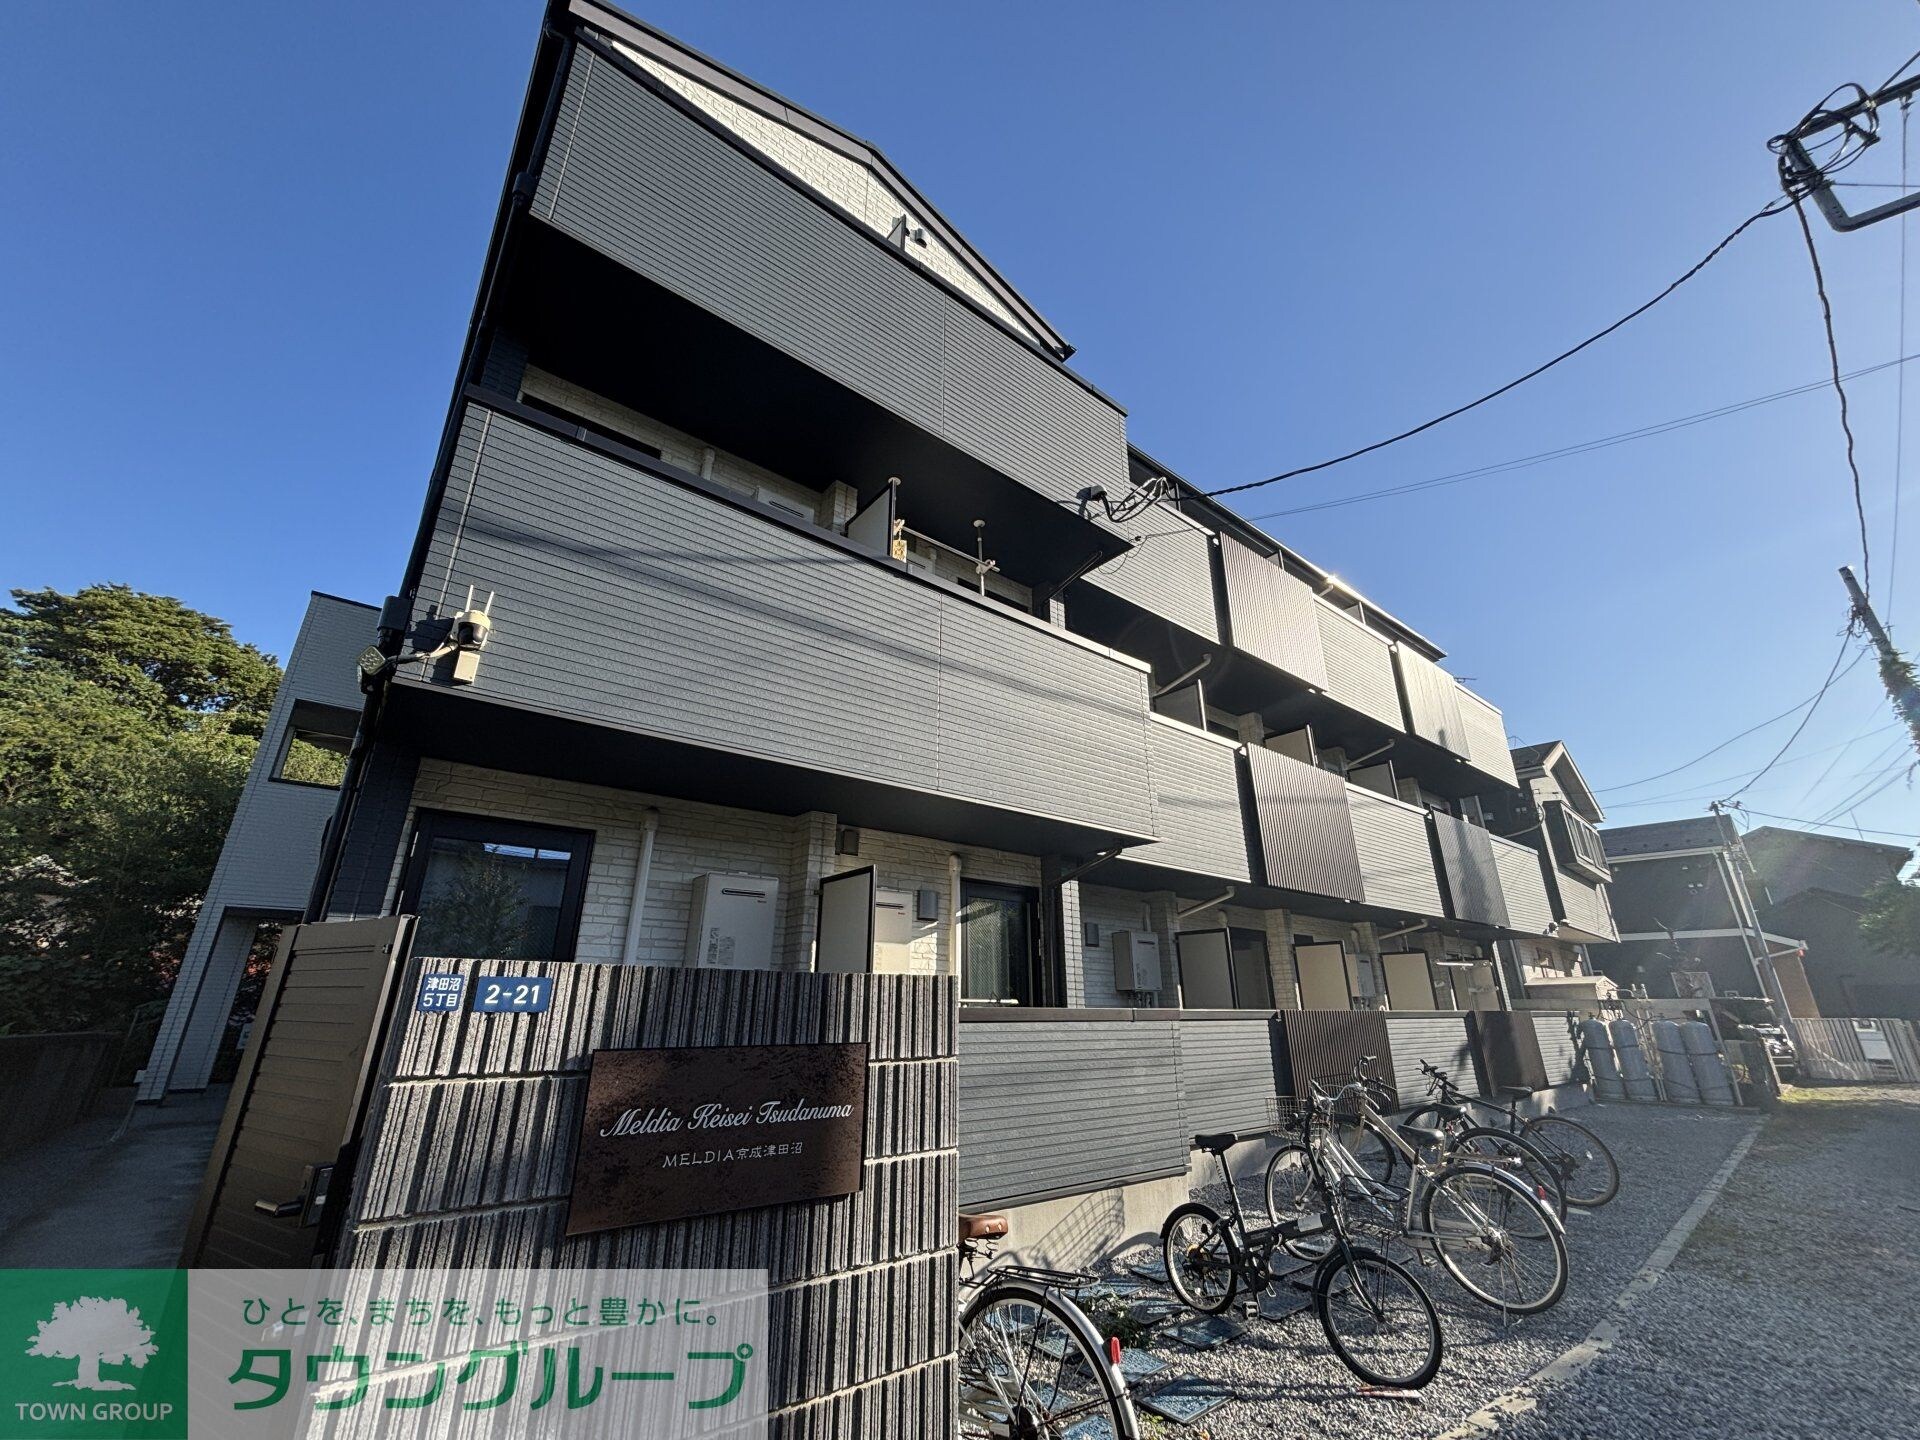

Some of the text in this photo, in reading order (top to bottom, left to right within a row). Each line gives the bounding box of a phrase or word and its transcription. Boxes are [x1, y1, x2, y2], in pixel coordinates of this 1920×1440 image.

[426, 977, 462, 992] 津田沼
[423, 992, 458, 1007] 5丁目
[484, 984, 540, 1005] 2-21
[600, 1098, 854, 1138] Meldia Keisei Tsudanuma
